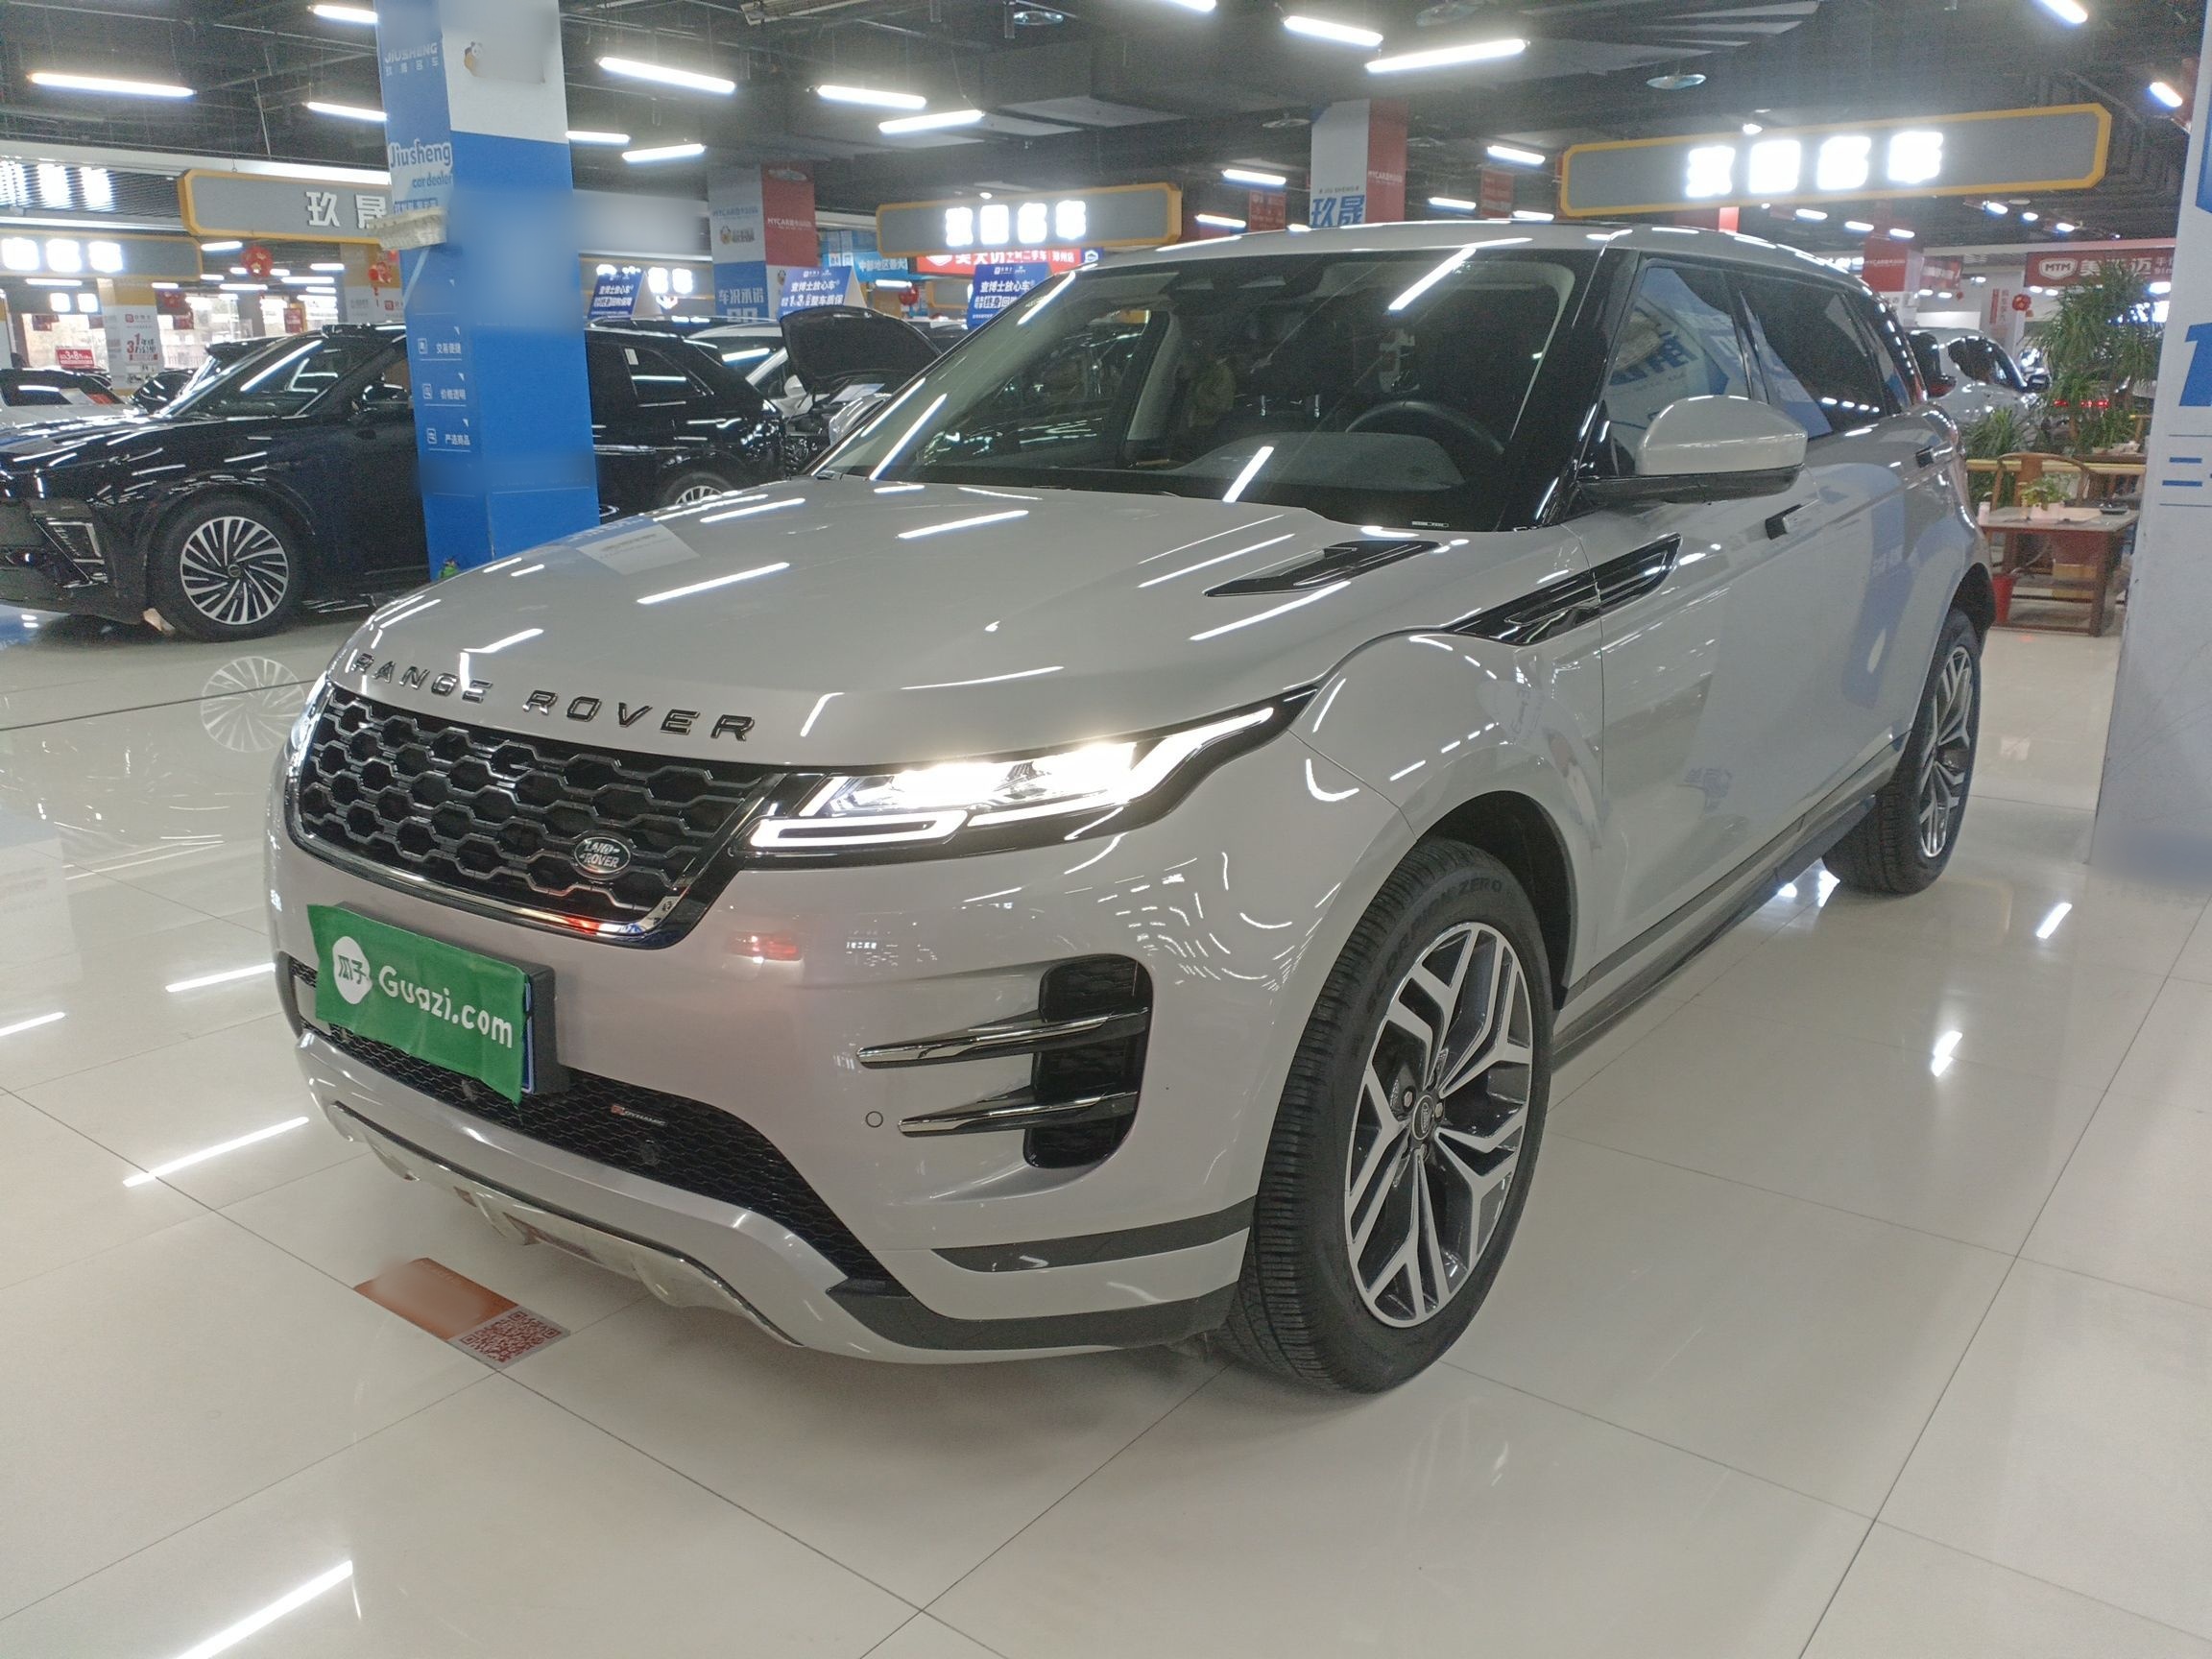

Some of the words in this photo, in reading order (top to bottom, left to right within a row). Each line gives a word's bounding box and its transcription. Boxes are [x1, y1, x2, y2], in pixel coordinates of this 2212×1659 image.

[389, 139, 452, 168] Jiusheng
[2045, 262, 2072, 274] MTM
[350, 653, 493, 704] RANGE
[522, 689, 756, 742] ROVER
[584, 853, 619, 868] ROVER
[585, 842, 614, 855] LAND
[338, 955, 370, 985] 瓜子
[378, 965, 513, 1049] Guazi.com
